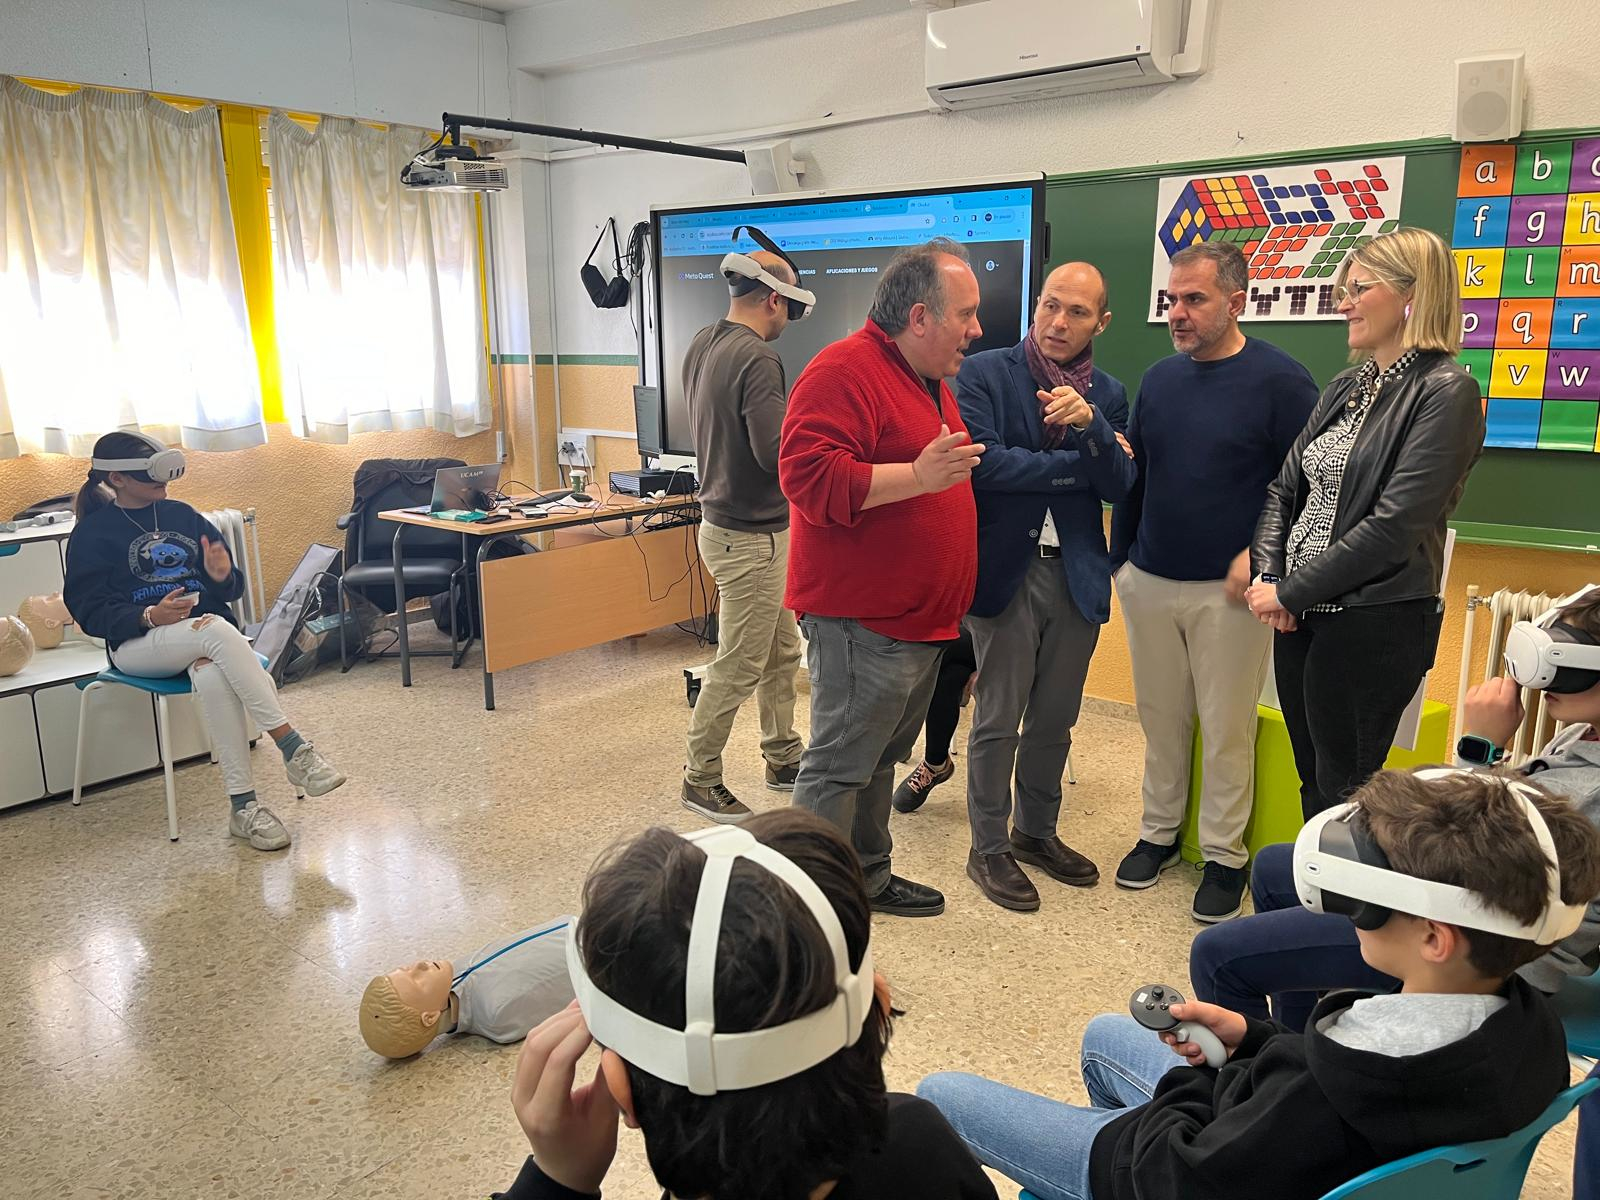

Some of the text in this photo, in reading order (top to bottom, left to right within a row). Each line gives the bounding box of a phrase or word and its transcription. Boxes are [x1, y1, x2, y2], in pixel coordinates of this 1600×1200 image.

[1475, 160, 1498, 183] a
[1532, 150, 1552, 181] b
[1473, 201, 1600, 243] f g h
[699, 272, 714, 280] Quest
[1464, 253, 1600, 286] k l m
[1459, 311, 1588, 344] p q r
[1508, 365, 1591, 387] v w
